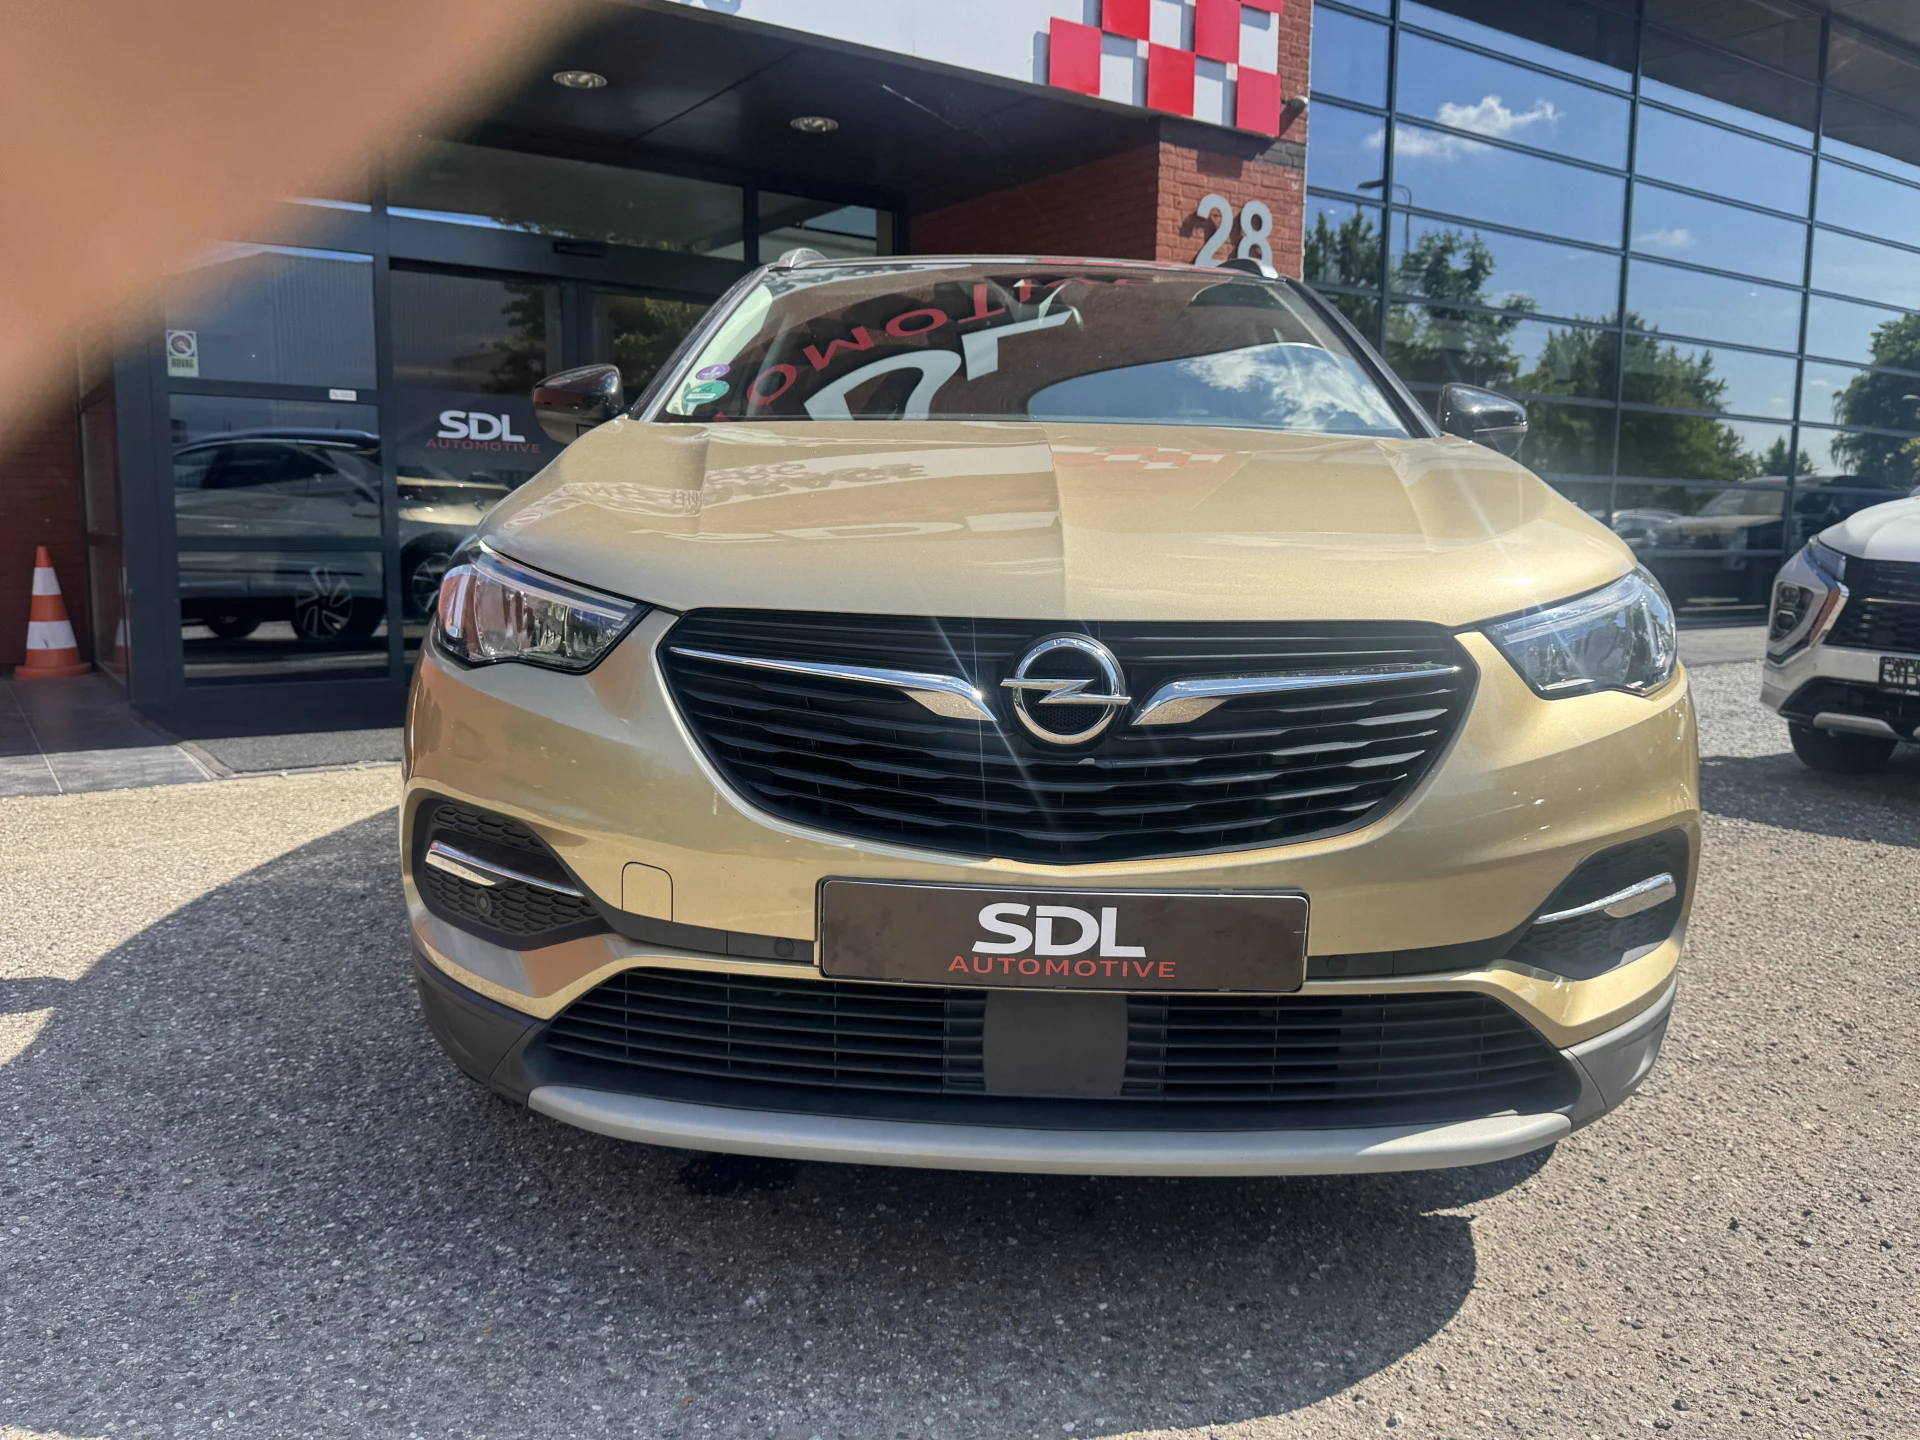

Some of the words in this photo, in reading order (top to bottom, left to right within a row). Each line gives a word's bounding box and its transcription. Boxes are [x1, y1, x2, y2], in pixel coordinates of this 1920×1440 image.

[1194, 193, 1273, 267] 28
[437, 409, 526, 443] SDL
[425, 438, 541, 454] AUTOMOTIVE
[971, 901, 1147, 958] SDL
[947, 954, 1176, 979] AUTOMOTIVE
